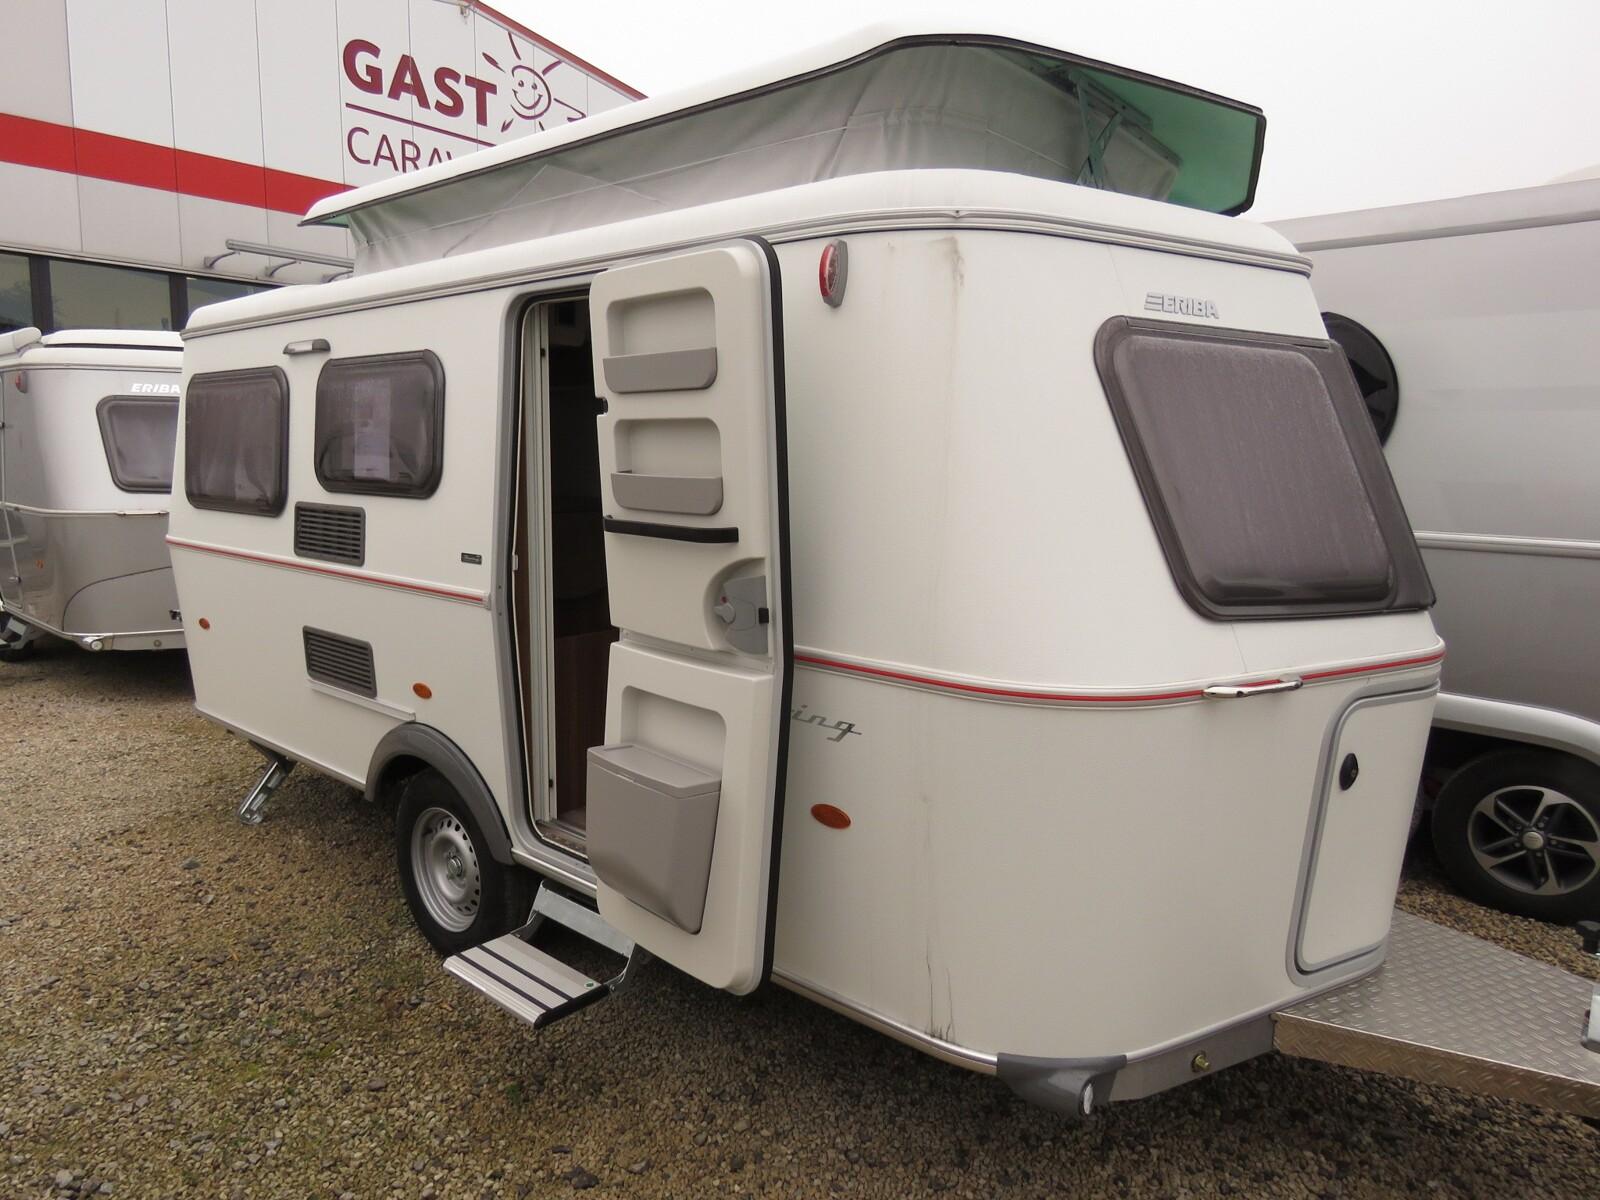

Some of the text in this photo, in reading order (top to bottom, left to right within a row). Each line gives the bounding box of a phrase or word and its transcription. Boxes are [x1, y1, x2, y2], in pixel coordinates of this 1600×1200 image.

[343, 39, 498, 127] GAST
[347, 127, 453, 173] CARA
[1161, 294, 1220, 319] ERIBA
[130, 383, 181, 394] ERIBA
